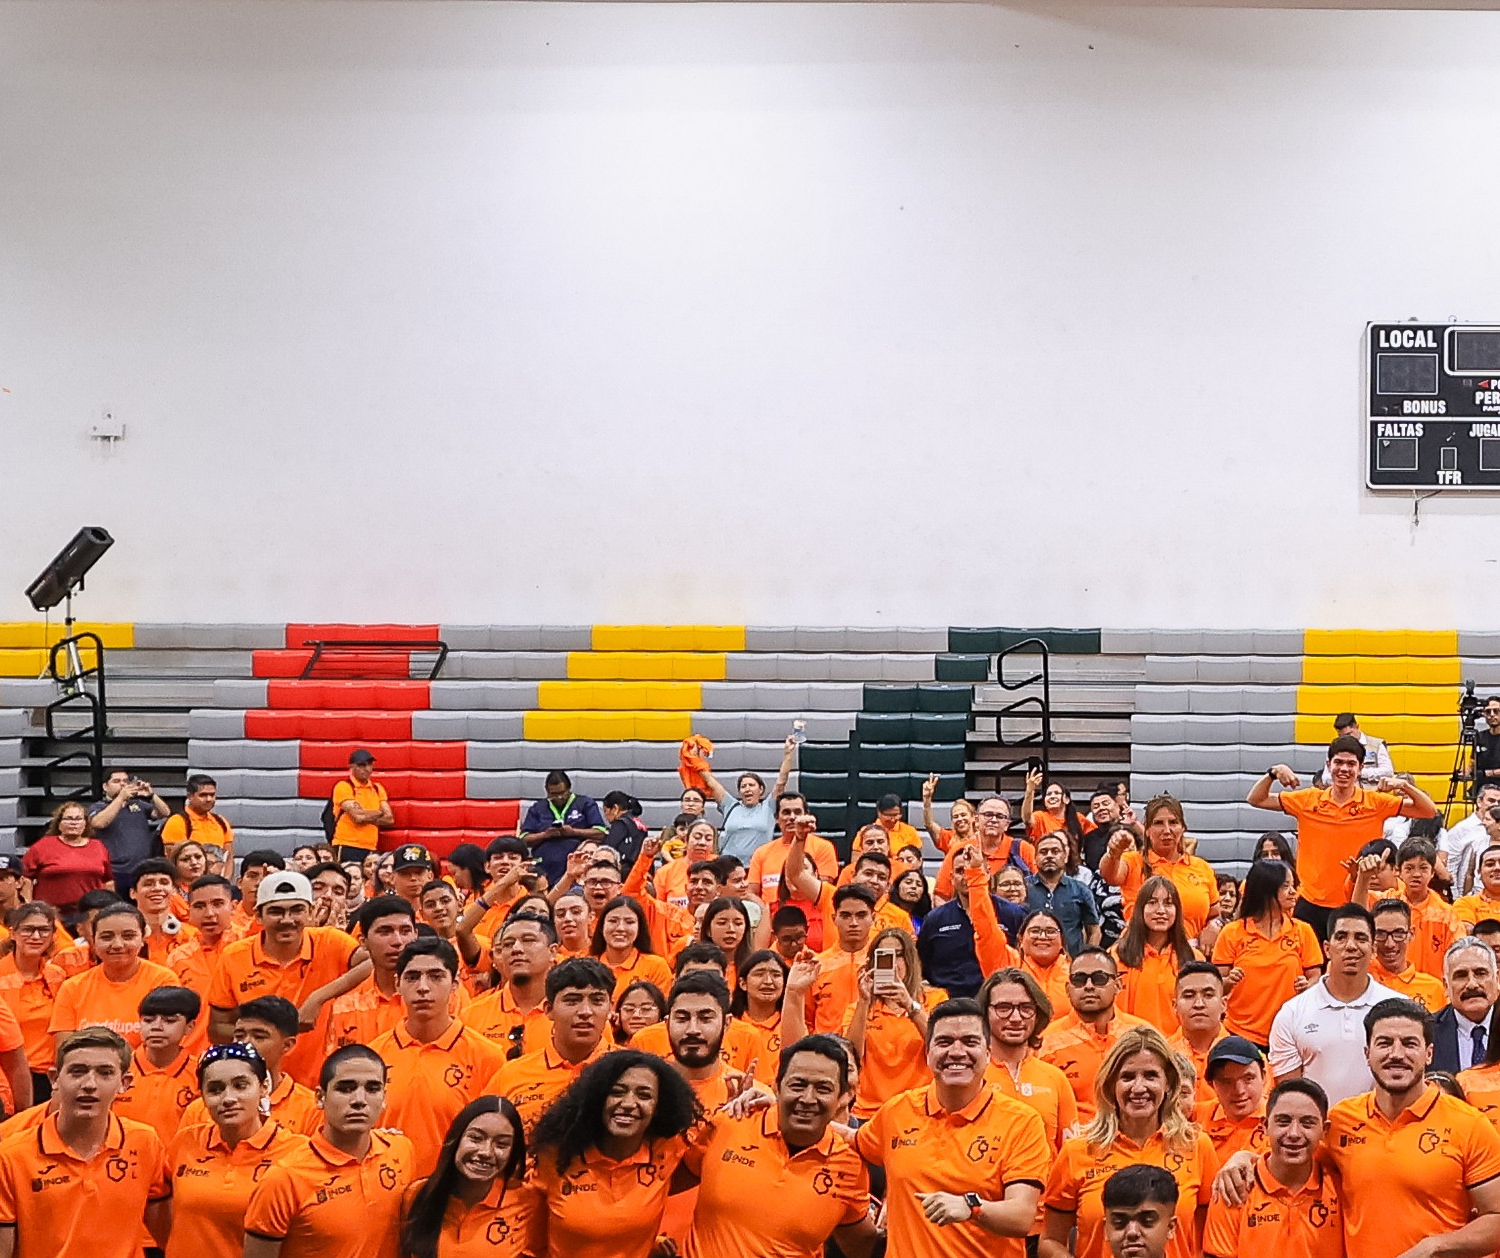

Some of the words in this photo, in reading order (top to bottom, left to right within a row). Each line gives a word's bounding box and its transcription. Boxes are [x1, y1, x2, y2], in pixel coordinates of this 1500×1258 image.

[1379, 330, 1438, 349] LOCAL
[1403, 400, 1446, 414] BONUS
[1377, 423, 1424, 437] FALTAS
[1437, 471, 1462, 485] TFR
[1348, 1136, 1367, 1145] INDE
[732, 1155, 755, 1167] INDE
[45, 1175, 70, 1185] INDE
[326, 1184, 352, 1197] INDE
[572, 1183, 597, 1193] INDE
[1257, 1213, 1280, 1223] INDE
